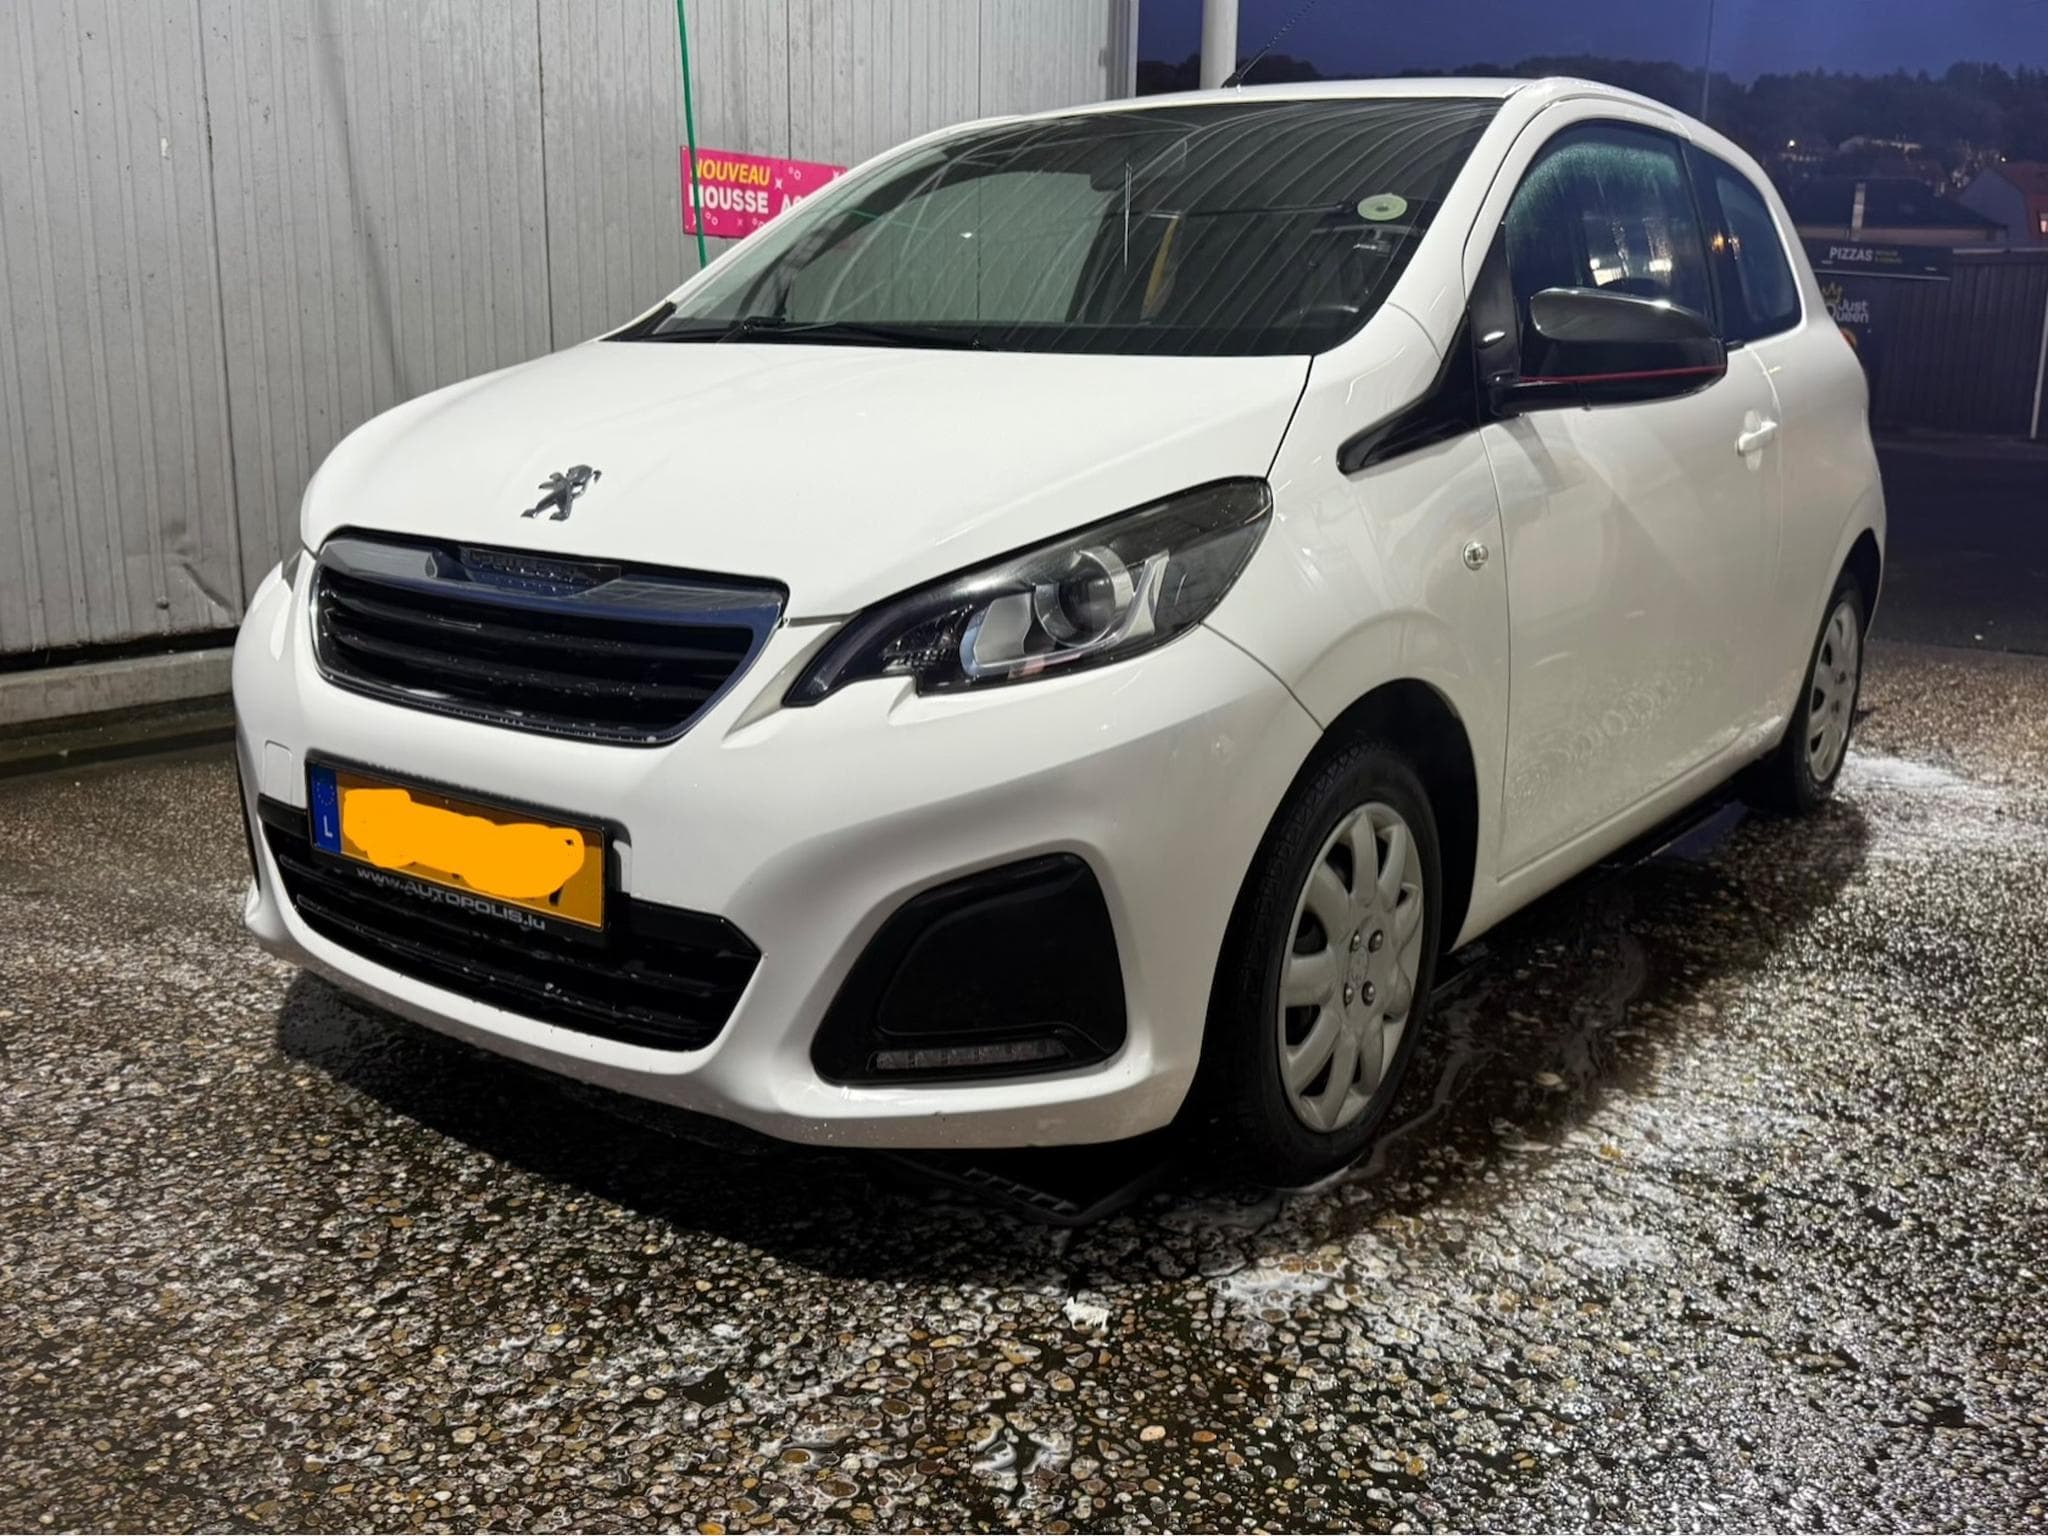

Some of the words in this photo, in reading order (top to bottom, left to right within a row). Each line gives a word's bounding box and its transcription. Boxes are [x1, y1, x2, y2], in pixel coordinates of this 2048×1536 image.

[1829, 247, 1874, 262] PIZZAS
[1838, 299, 1869, 313] Just
[322, 816, 334, 838] L
